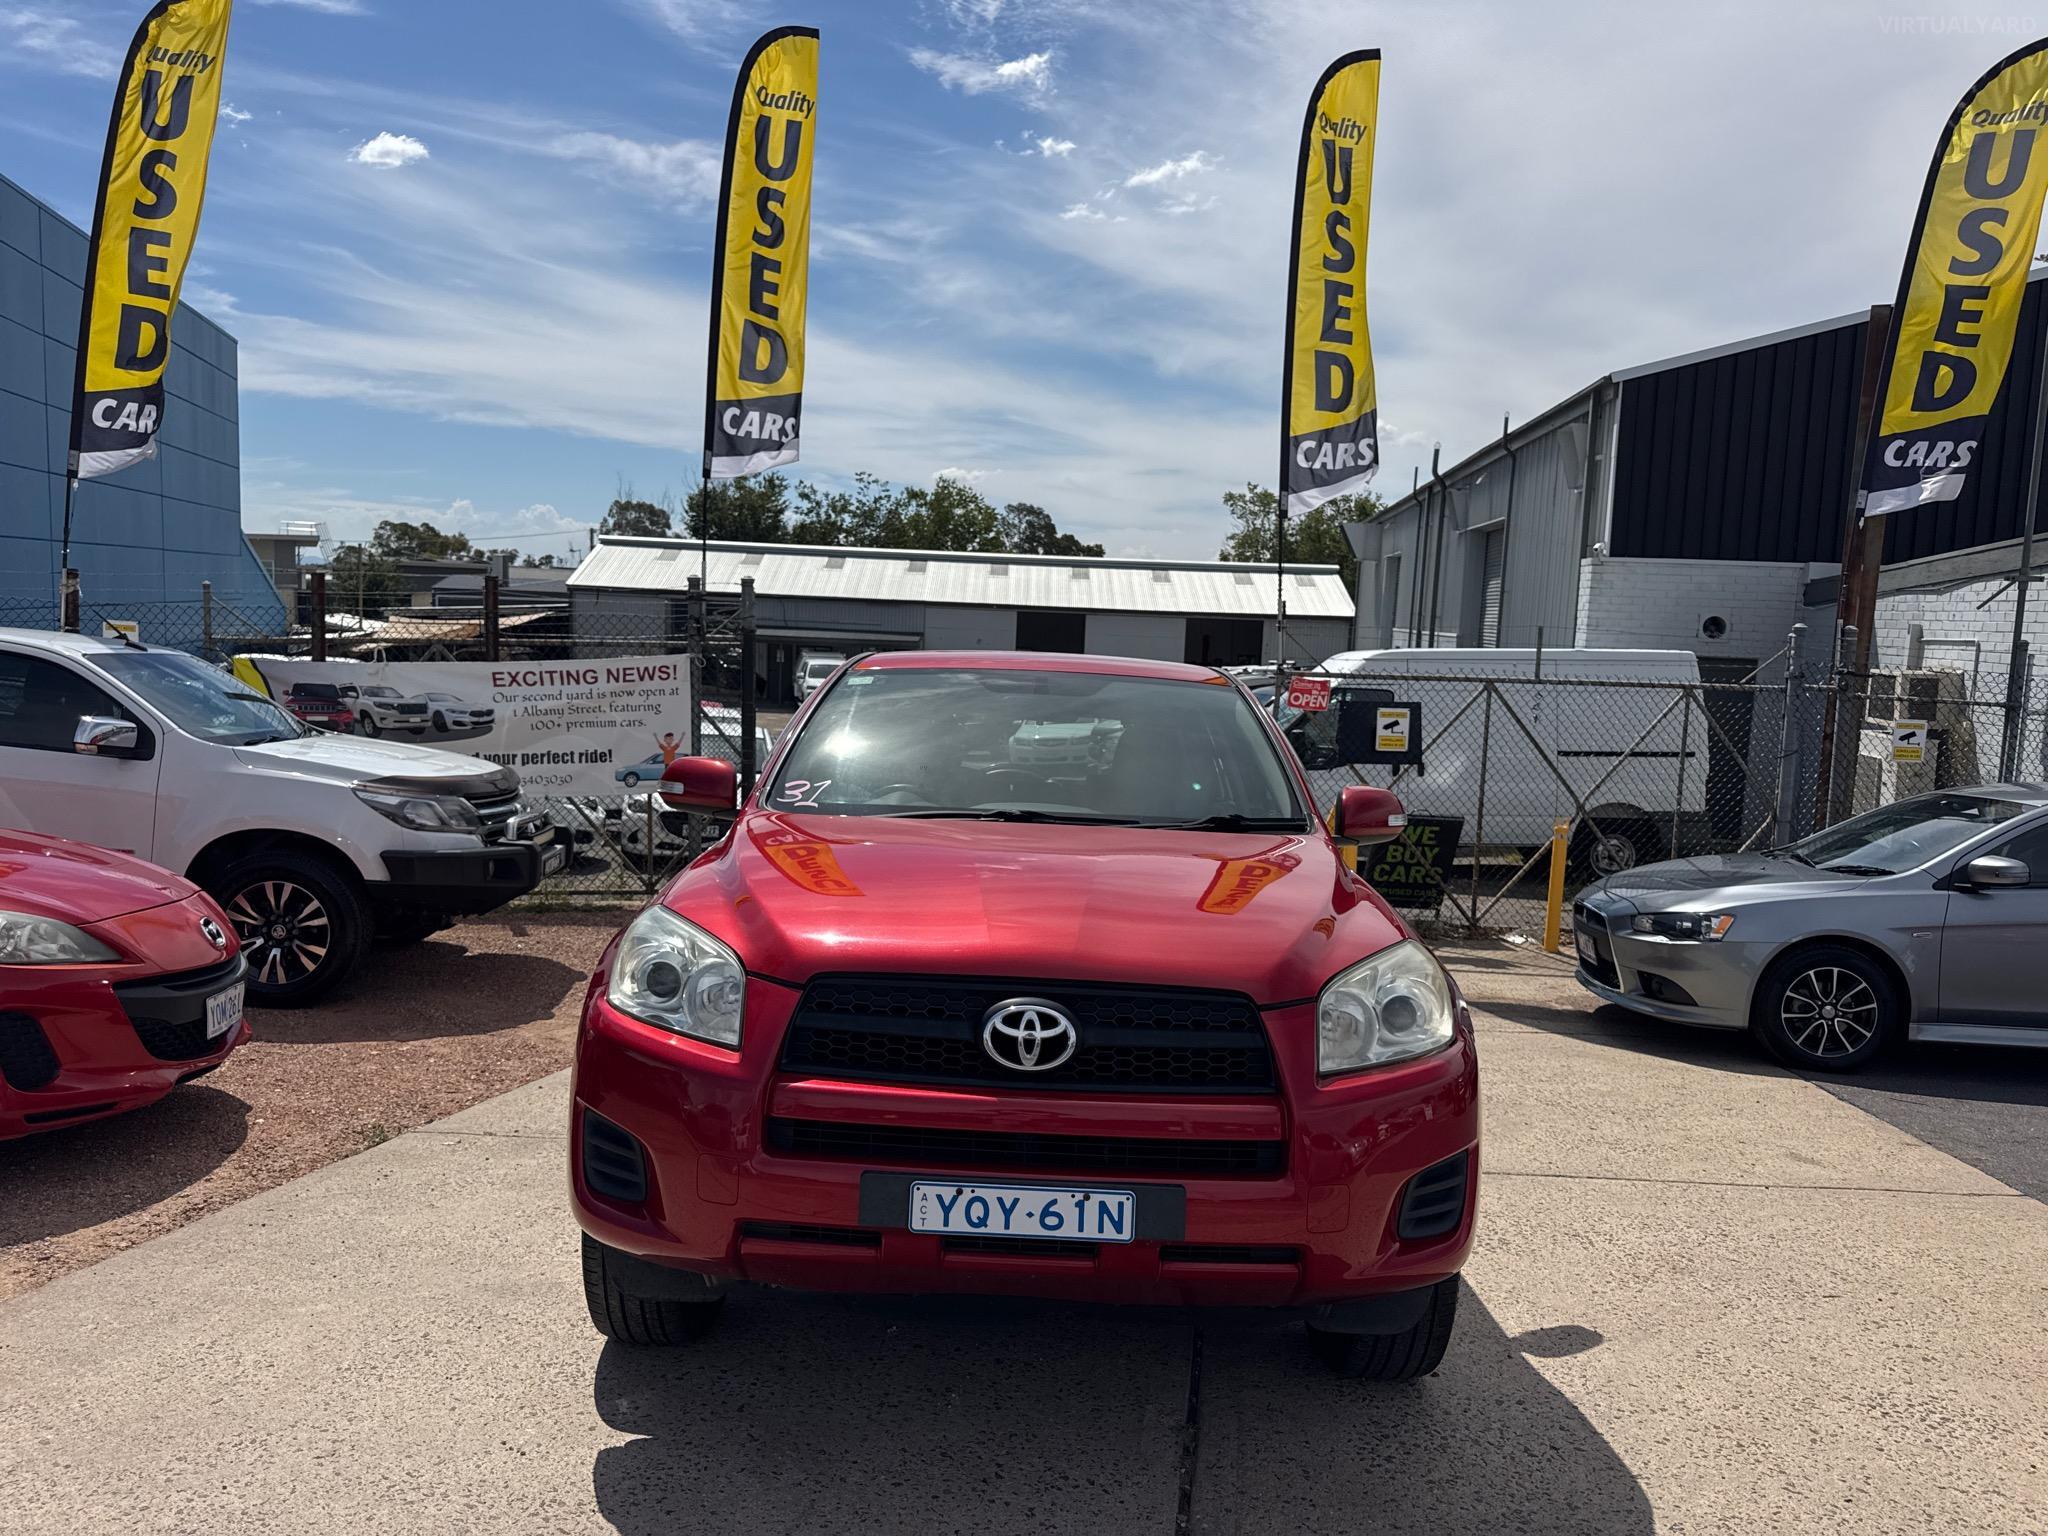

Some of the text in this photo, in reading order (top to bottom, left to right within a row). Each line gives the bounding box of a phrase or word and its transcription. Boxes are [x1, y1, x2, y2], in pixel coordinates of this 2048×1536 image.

[756, 86, 815, 119] Quality
[115, 69, 194, 373] USED
[739, 114, 802, 385] USED
[1314, 139, 1355, 414] USED
[1910, 128, 2037, 413] USED
[92, 398, 158, 433] CAR
[722, 406, 797, 442] CARS
[1296, 437, 1375, 470] CARS
[1883, 439, 1978, 468] CARS
[491, 664, 678, 688] EXCITING NEWS!
[492, 686, 680, 705] Our second yard is now open at
[521, 706, 565, 719] Albany
[567, 703, 606, 715] Street,
[609, 701, 662, 715] featuring
[1290, 692, 1328, 707] OPEN
[530, 715, 647, 732] 100+ premium cars.
[521, 750, 575, 767] perfect
[579, 749, 613, 764] ride!
[777, 780, 832, 808] 31
[1386, 844, 1440, 864] BUY
[1372, 864, 1444, 884] CARS
[919, 1192, 928, 1227] ACT
